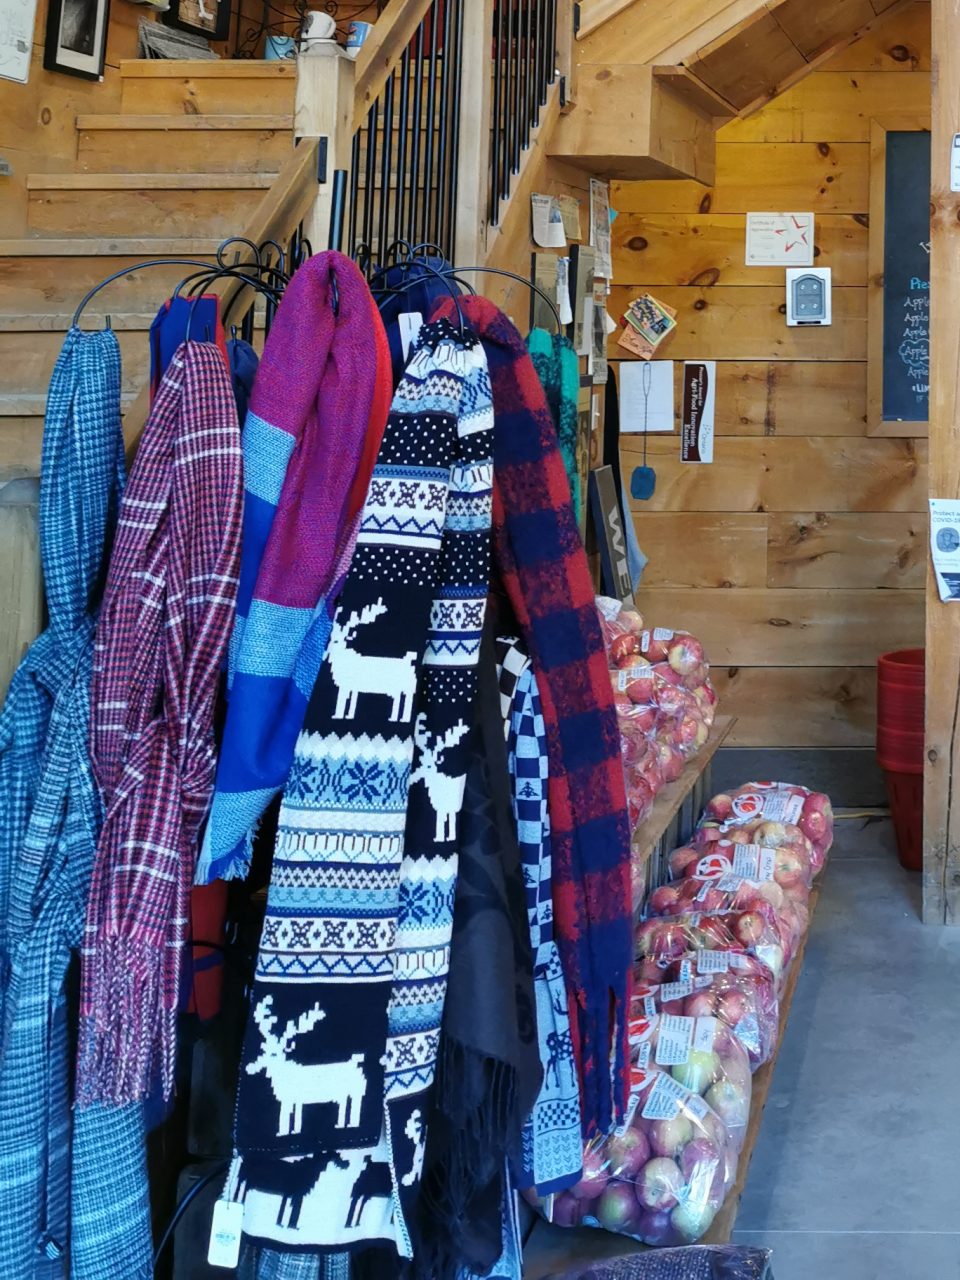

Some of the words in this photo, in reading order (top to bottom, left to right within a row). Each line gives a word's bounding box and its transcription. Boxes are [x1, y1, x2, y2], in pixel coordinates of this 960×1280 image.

[904, 311, 928, 326] Apple
[903, 326, 928, 340] Apple
[904, 346, 928, 360] Apple
[908, 366, 928, 379] Apple
[690, 378, 698, 410] Agri-Food
[690, 412, 698, 447] Innovation
[683, 424, 691, 460] Excellence
